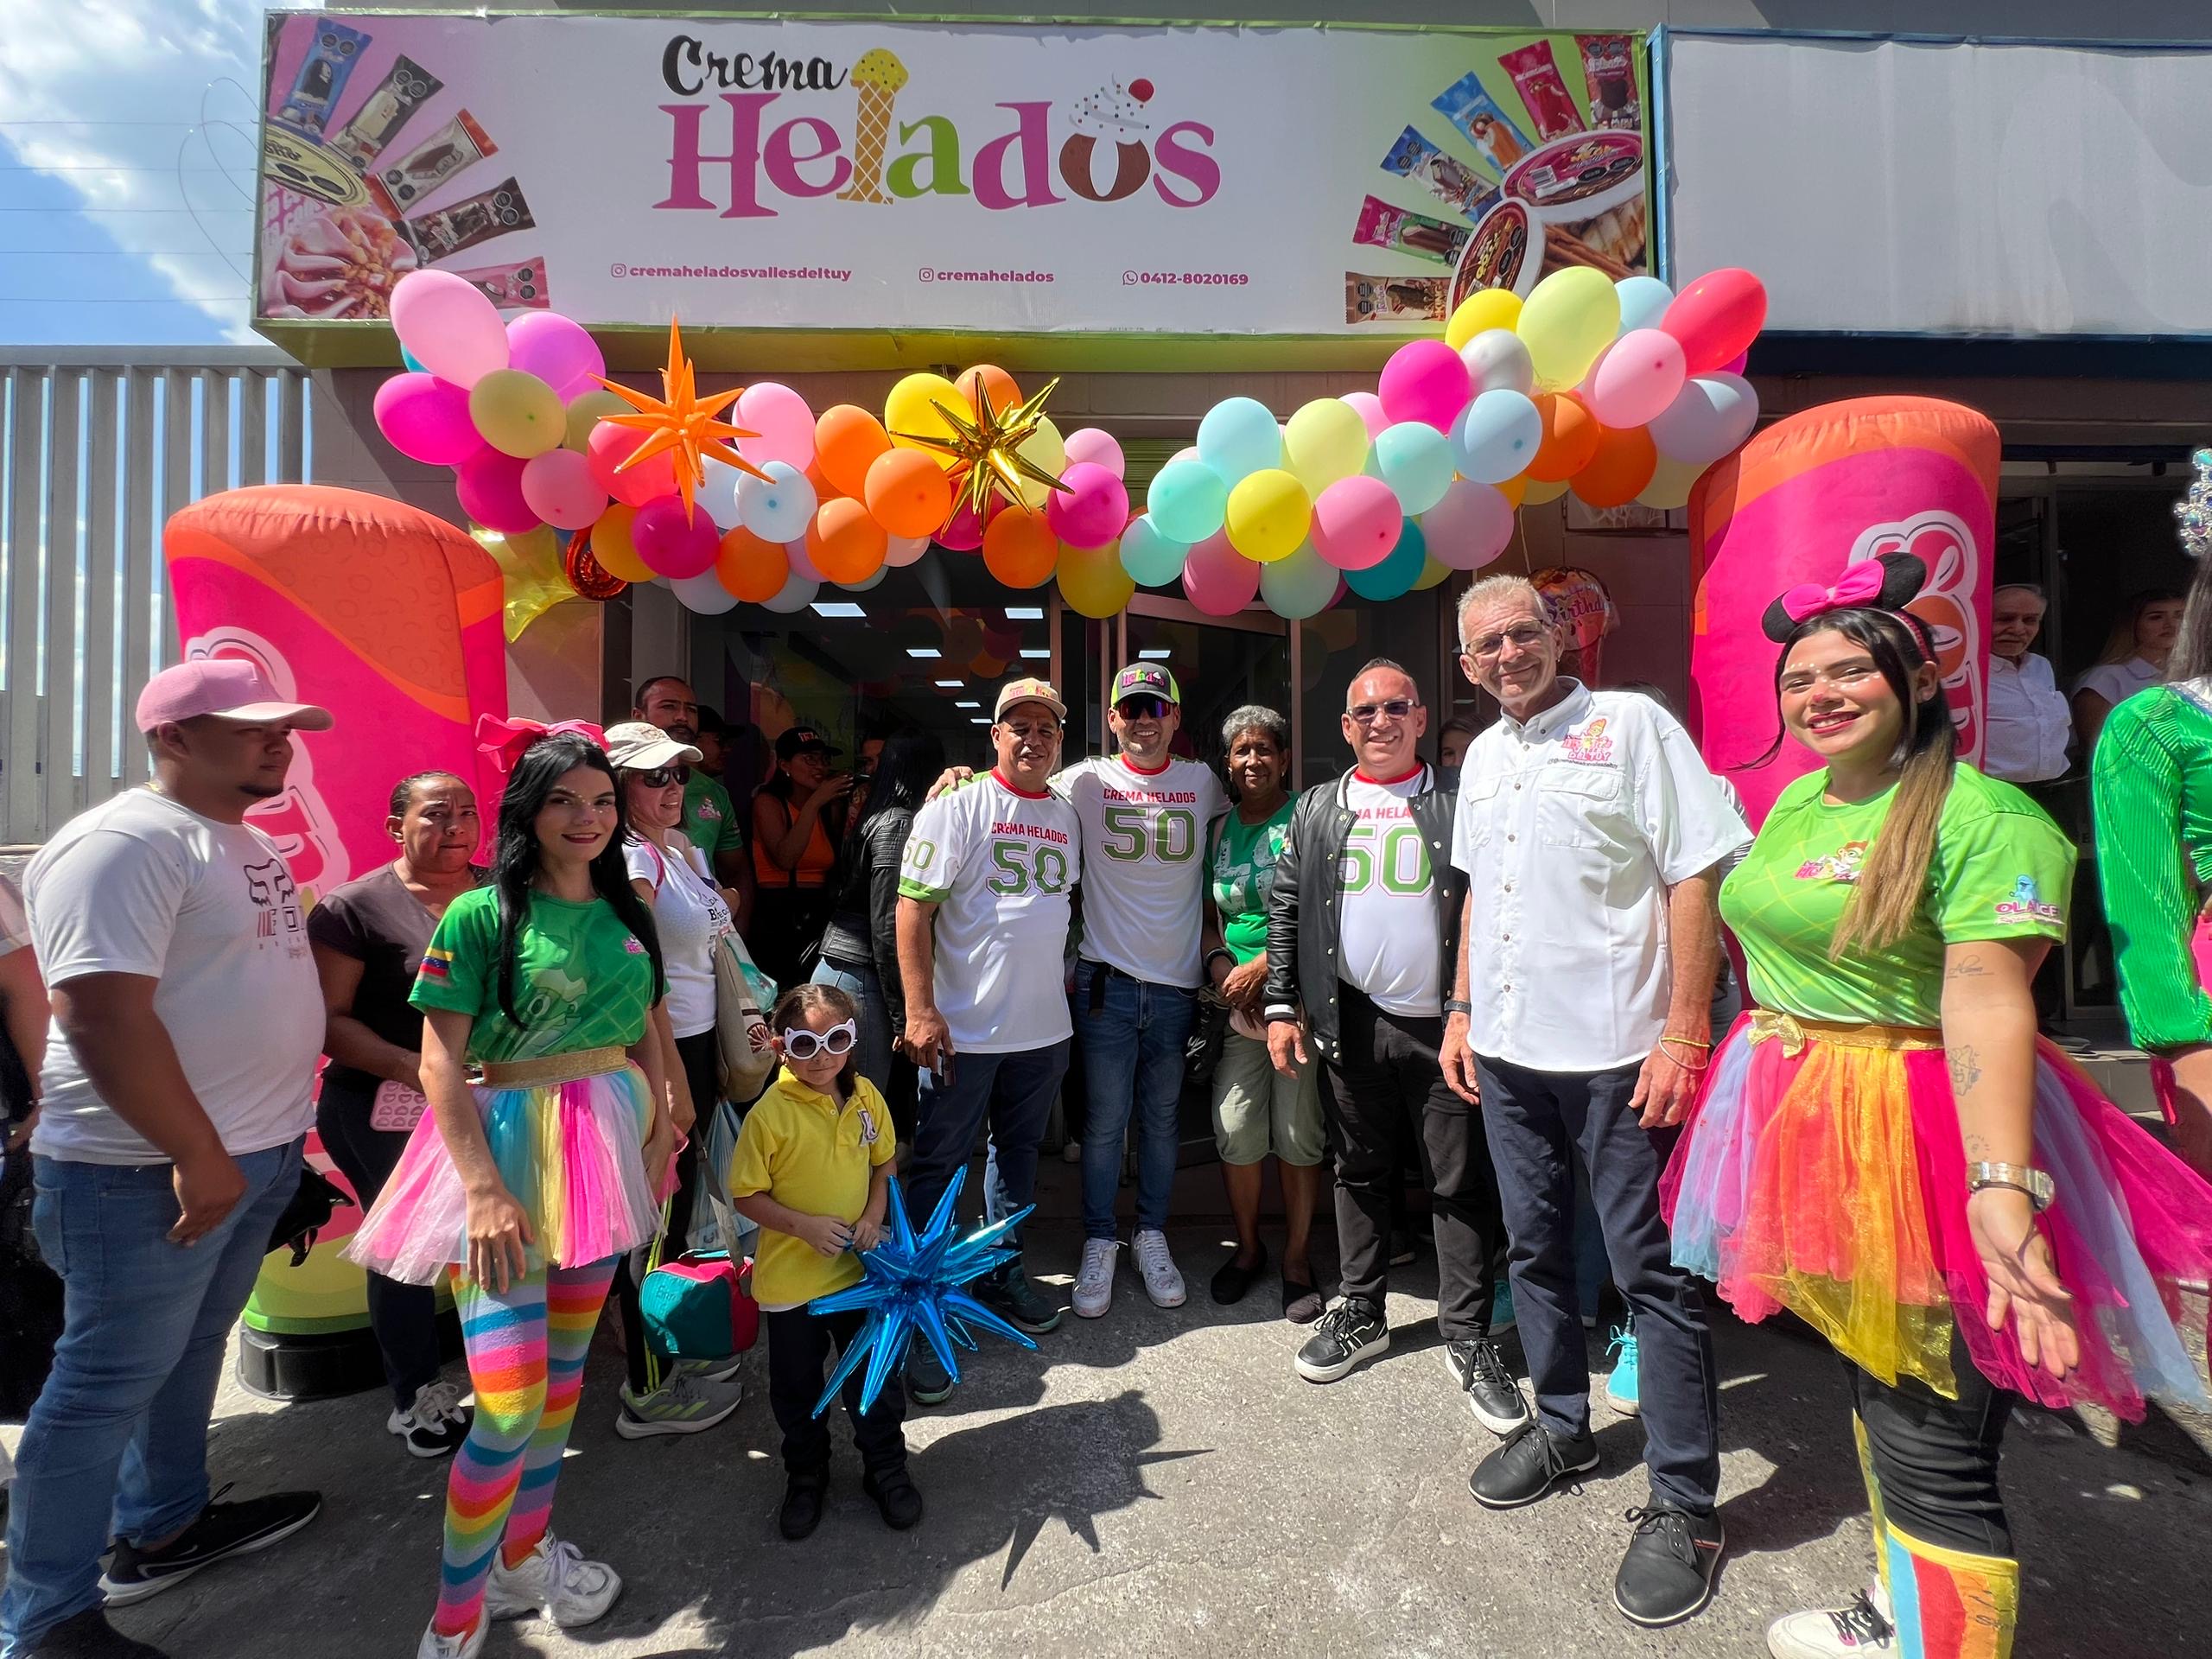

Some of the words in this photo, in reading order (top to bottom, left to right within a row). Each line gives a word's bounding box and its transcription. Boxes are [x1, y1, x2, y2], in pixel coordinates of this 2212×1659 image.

[660, 35, 849, 96] Crema
[652, 48, 1221, 219] Helados
[630, 265, 852, 283] cremaheladosvallesdeltuy
[937, 270, 1055, 283] cremahelados
[1140, 272, 1249, 286] 0412-8020169
[1103, 788, 1144, 802] CREMA
[1147, 791, 1196, 804] HELADOS
[1376, 806, 1414, 820] HELA
[991, 822, 1025, 835] CREMA
[1027, 823, 1068, 845] HELADOS
[1102, 803, 1197, 865] 50
[986, 838, 1069, 898] 50
